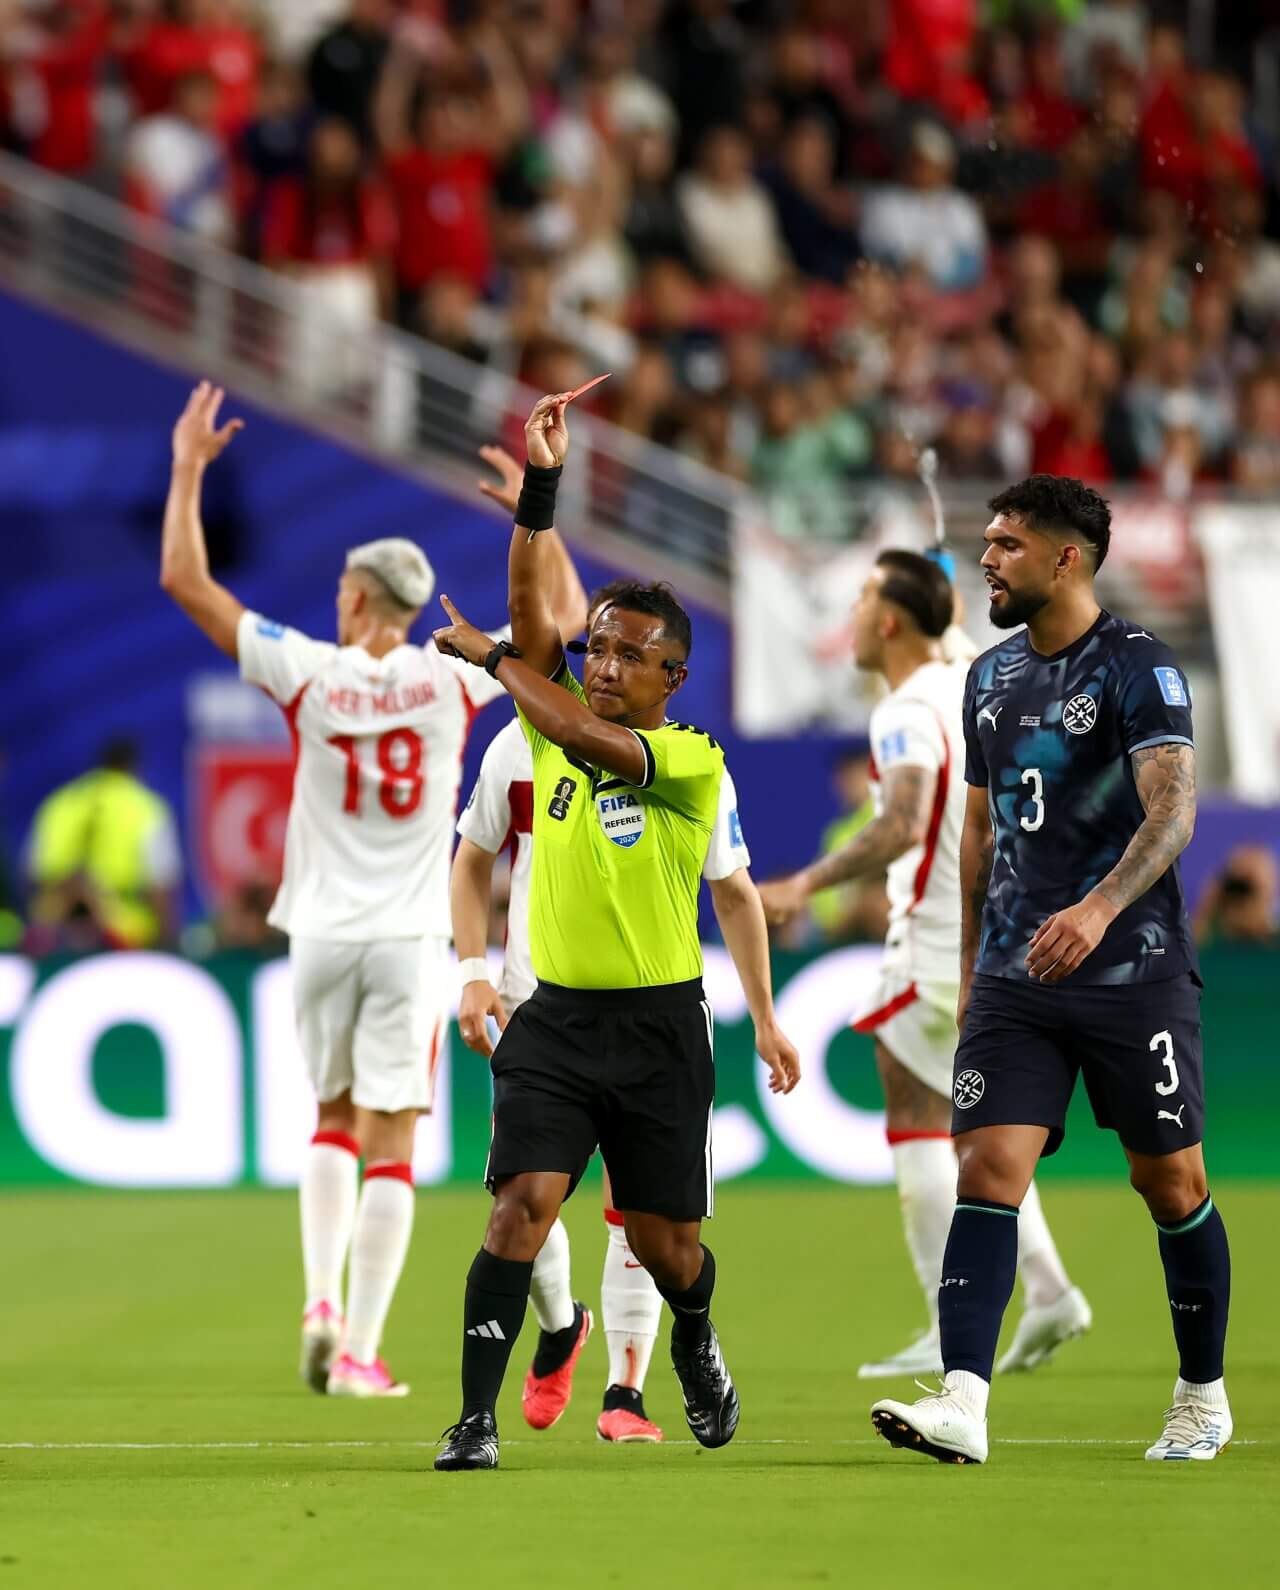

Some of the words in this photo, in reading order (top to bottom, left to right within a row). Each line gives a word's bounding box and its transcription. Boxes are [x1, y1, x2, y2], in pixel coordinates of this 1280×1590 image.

[326, 727, 424, 819] 18
[600, 793, 640, 813] FIFA
[1020, 768, 1045, 832] 3
[604, 814, 642, 829] REFEREE
[619, 834, 637, 845] 2026
[1149, 1029, 1180, 1096] 3
